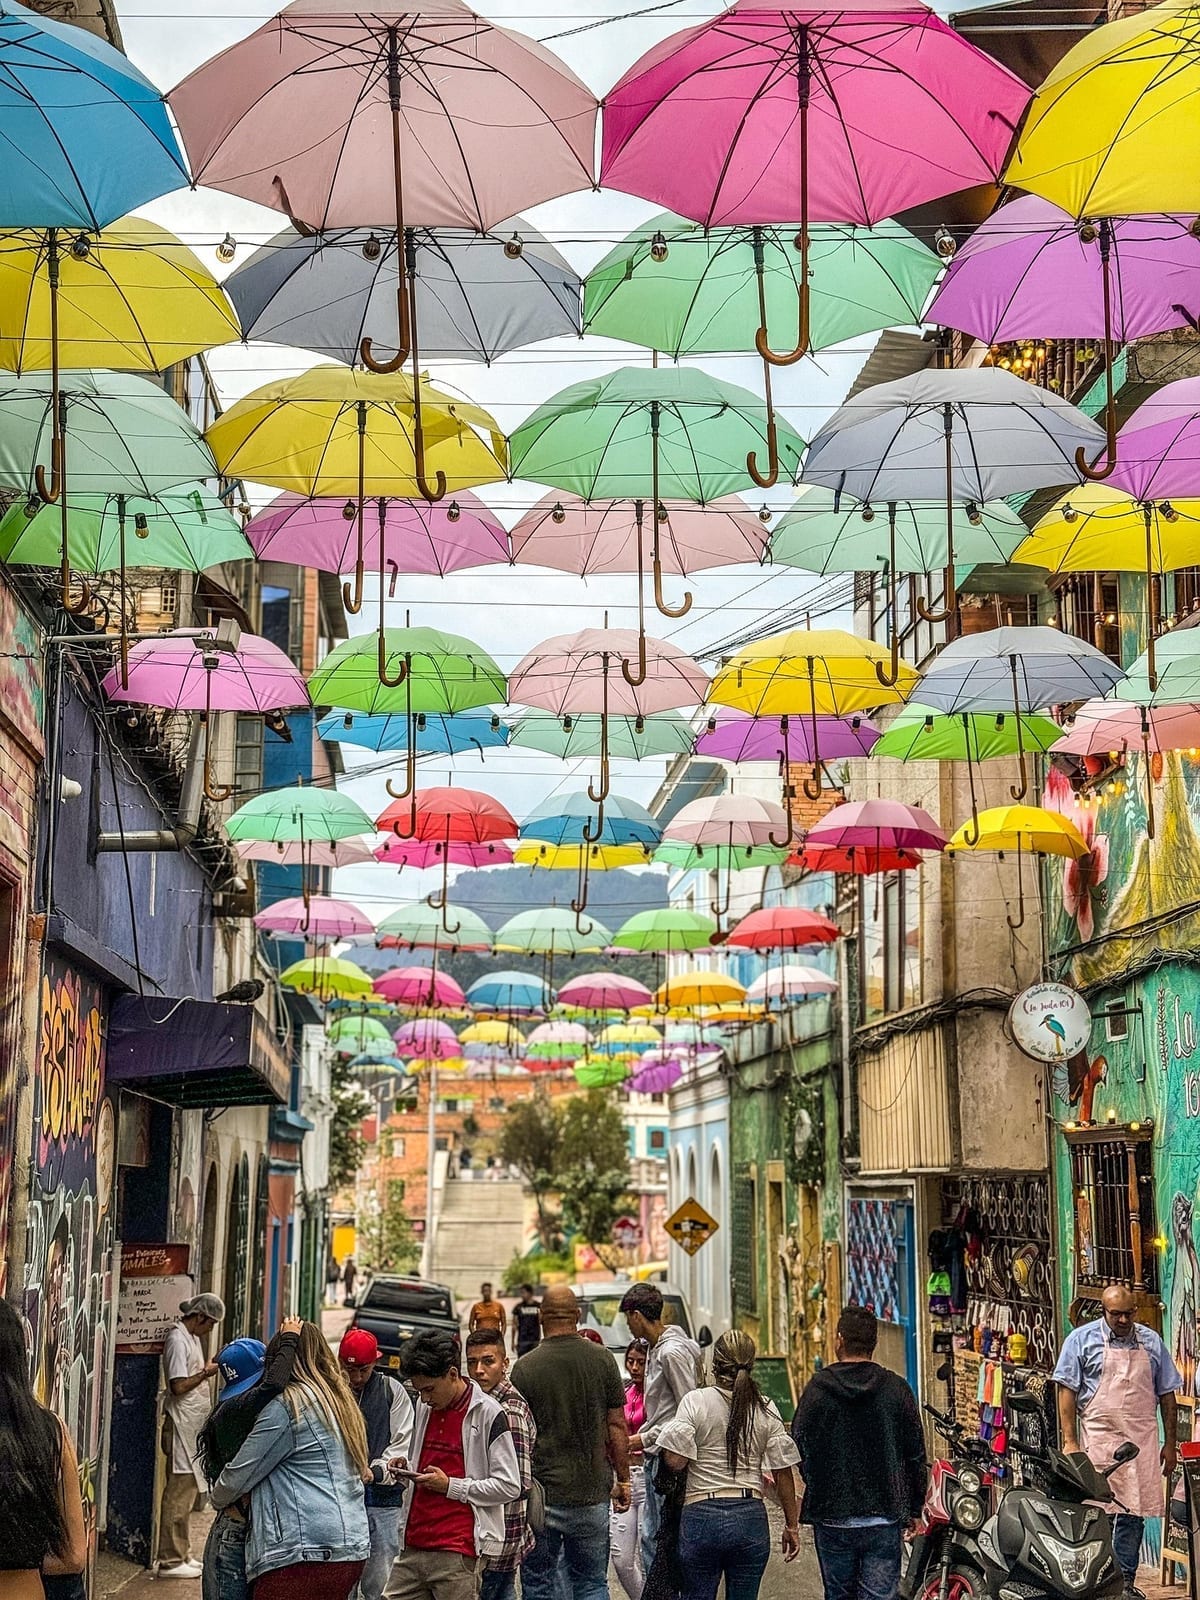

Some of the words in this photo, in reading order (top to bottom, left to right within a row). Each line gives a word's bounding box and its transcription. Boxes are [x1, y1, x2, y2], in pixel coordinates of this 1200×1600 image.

[1174, 995, 1197, 1058] La
[1182, 1071, 1200, 1118] 10
[121, 1255, 166, 1271] AMALES
[222, 1363, 239, 1380] LA
